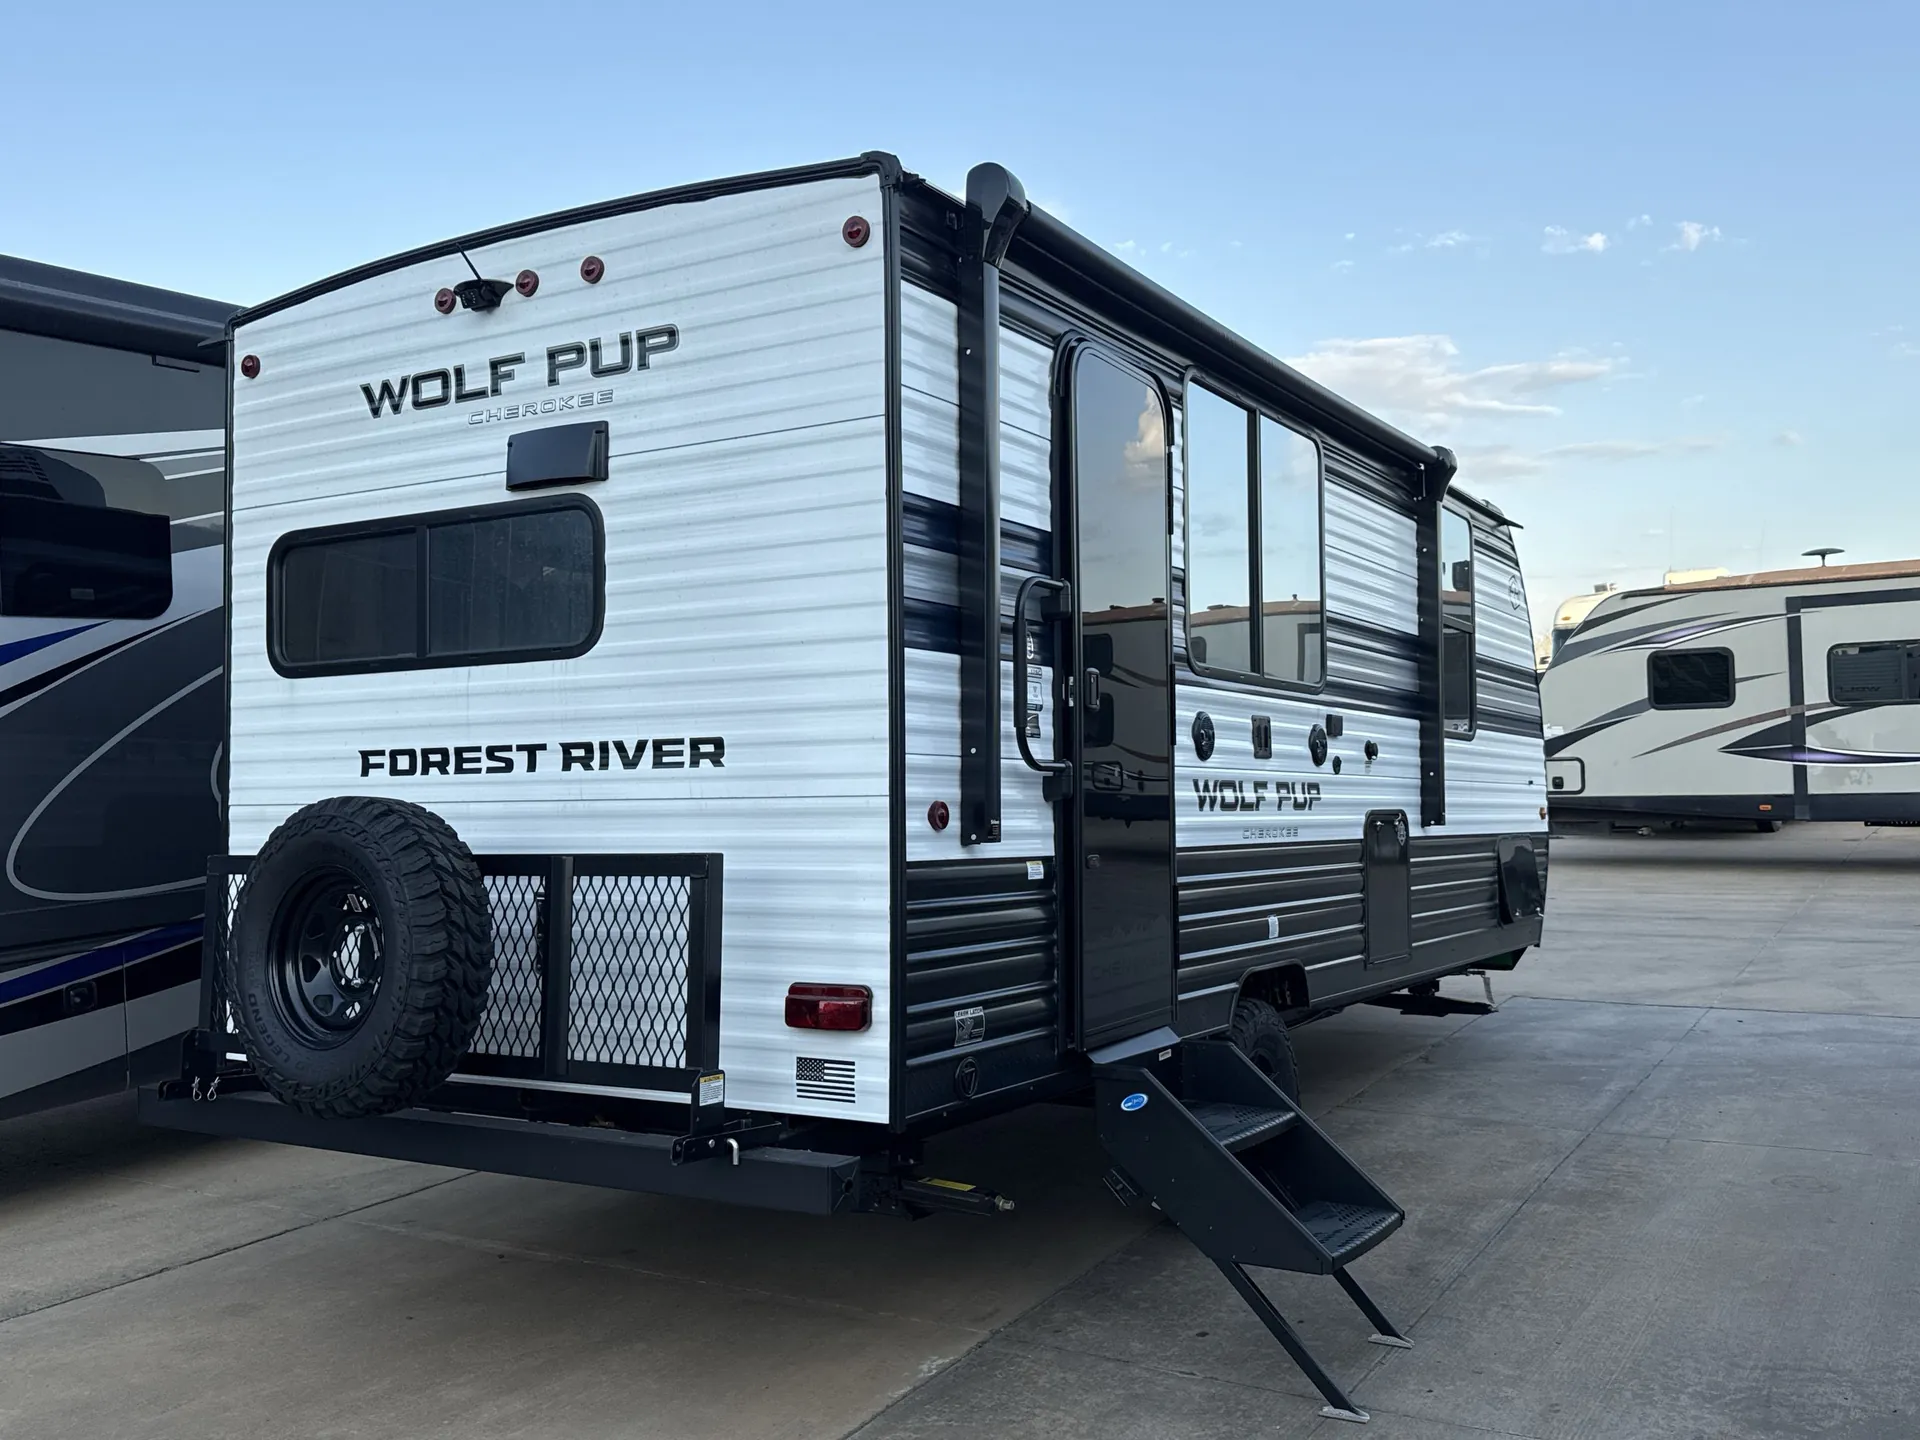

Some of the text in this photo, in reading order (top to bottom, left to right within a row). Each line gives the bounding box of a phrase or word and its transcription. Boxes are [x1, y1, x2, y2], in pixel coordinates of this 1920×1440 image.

[359, 323, 680, 419] WOLF PUP
[468, 389, 614, 425] CHEROKEE
[358, 736, 726, 777] FOREST RIVER
[1192, 779, 1322, 812] WOLF PUP
[1242, 826, 1299, 840] CHEROKEE
[247, 993, 290, 1063] LEGEND
